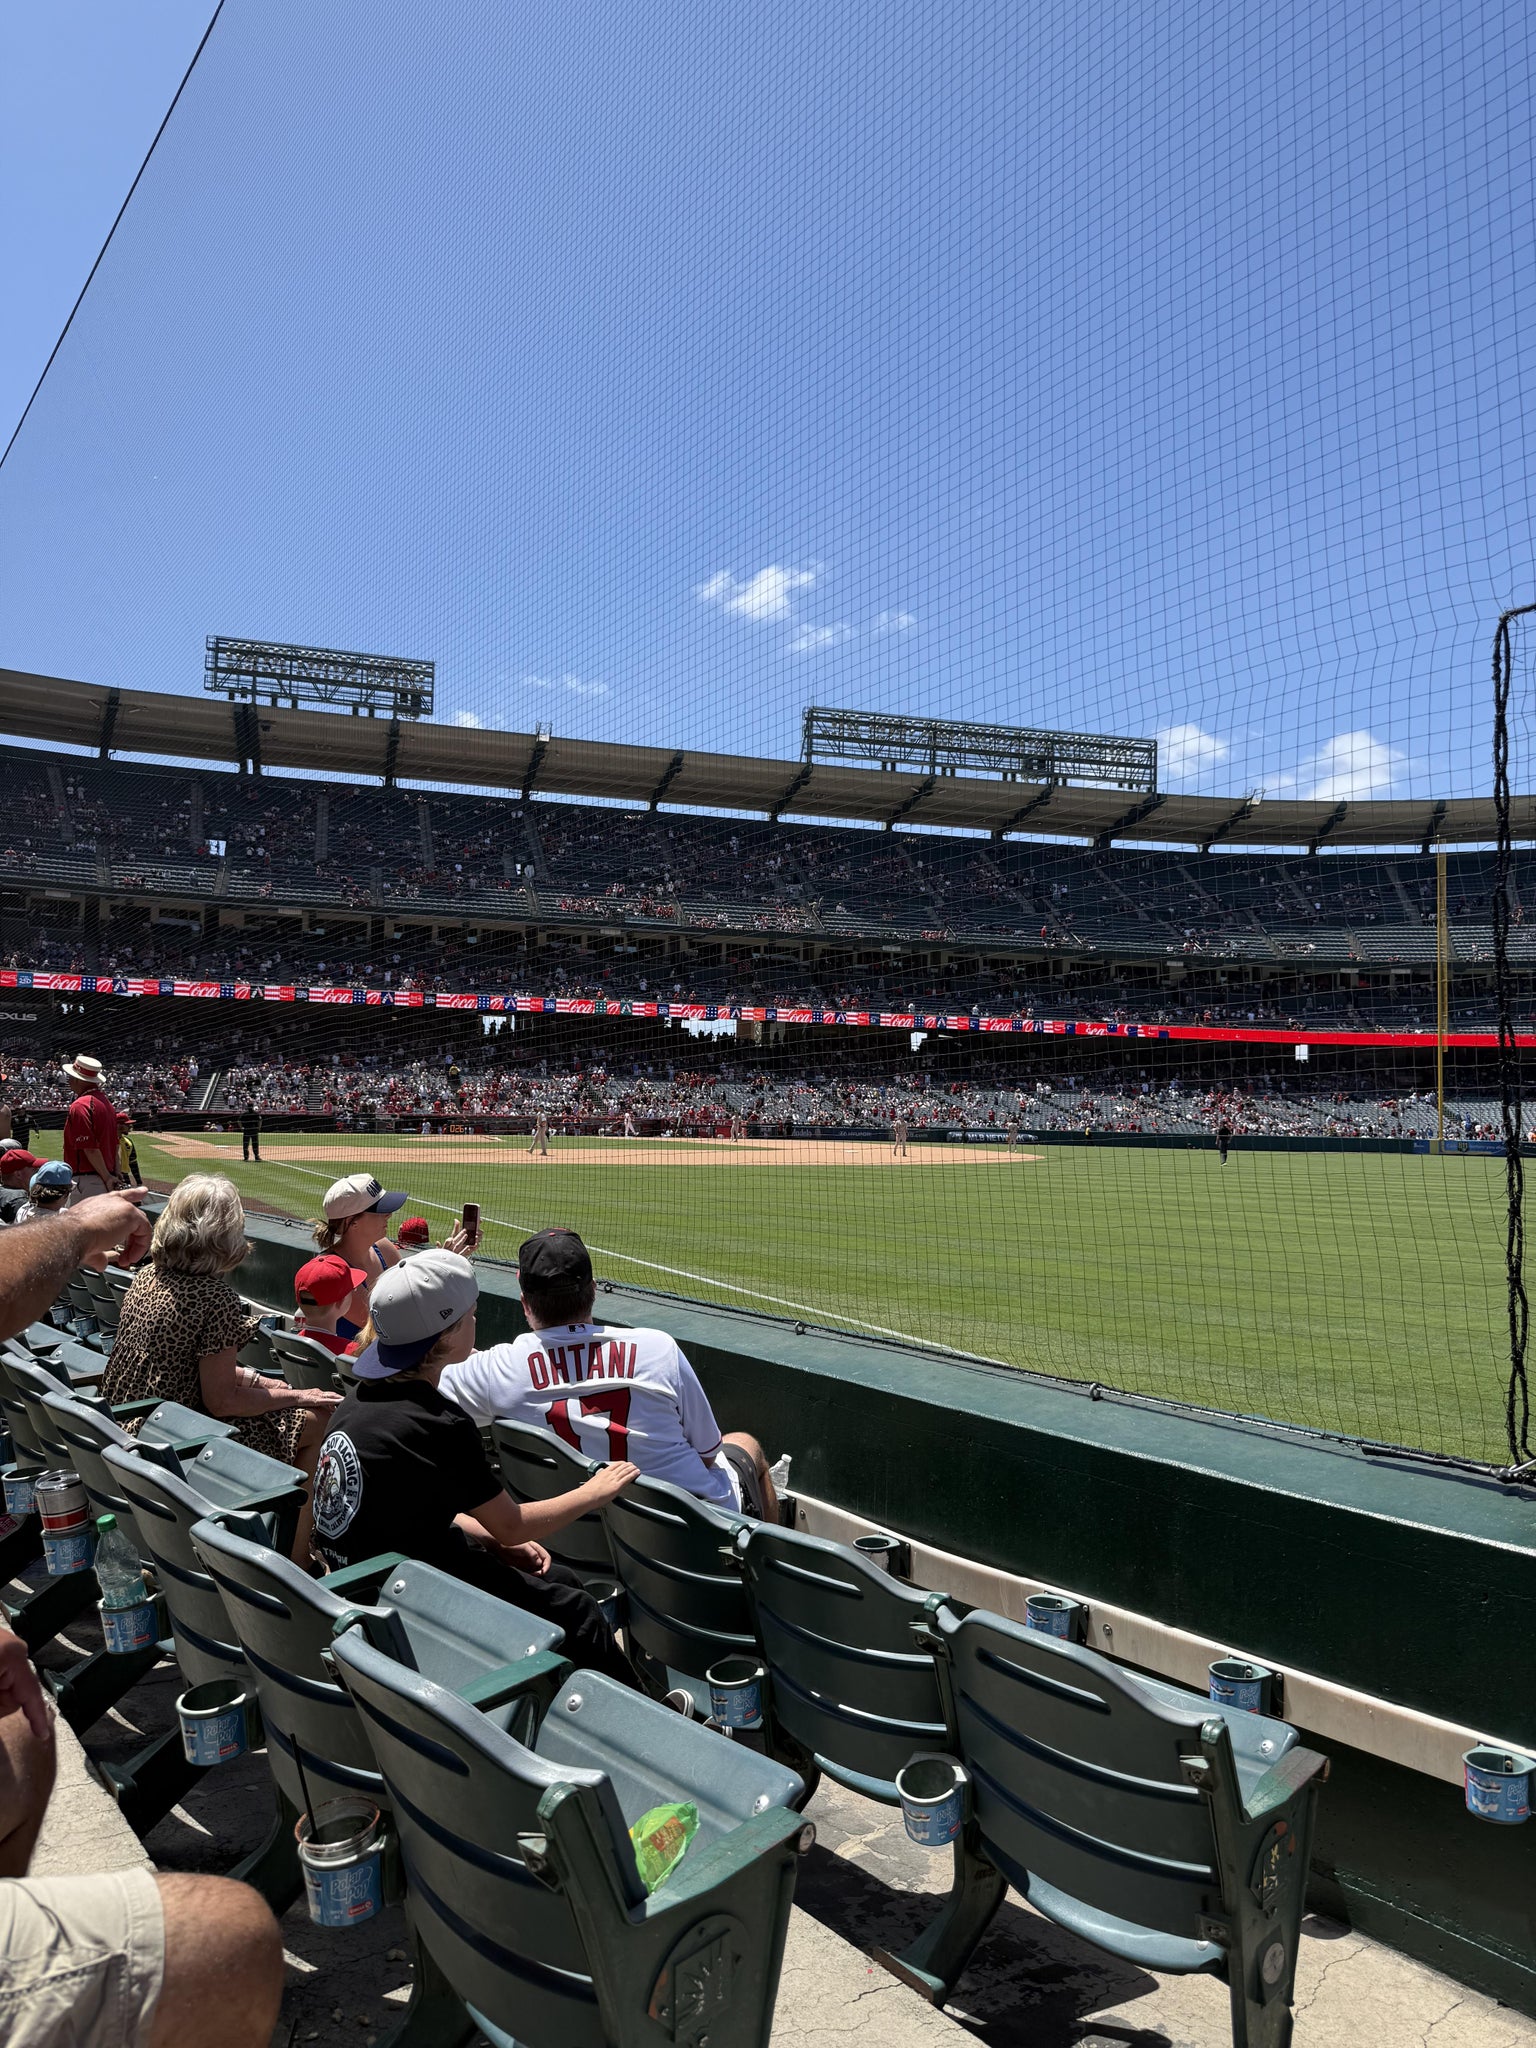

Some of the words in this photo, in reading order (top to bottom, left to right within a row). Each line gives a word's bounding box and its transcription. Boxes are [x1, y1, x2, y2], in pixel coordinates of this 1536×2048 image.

[0, 1012, 38, 1021] EXUS
[986, 1133, 1025, 1142] NETWK
[527, 1341, 637, 1391] OHTANI
[545, 1387, 631, 1462] 17
[338, 1439, 358, 1487] RACING
